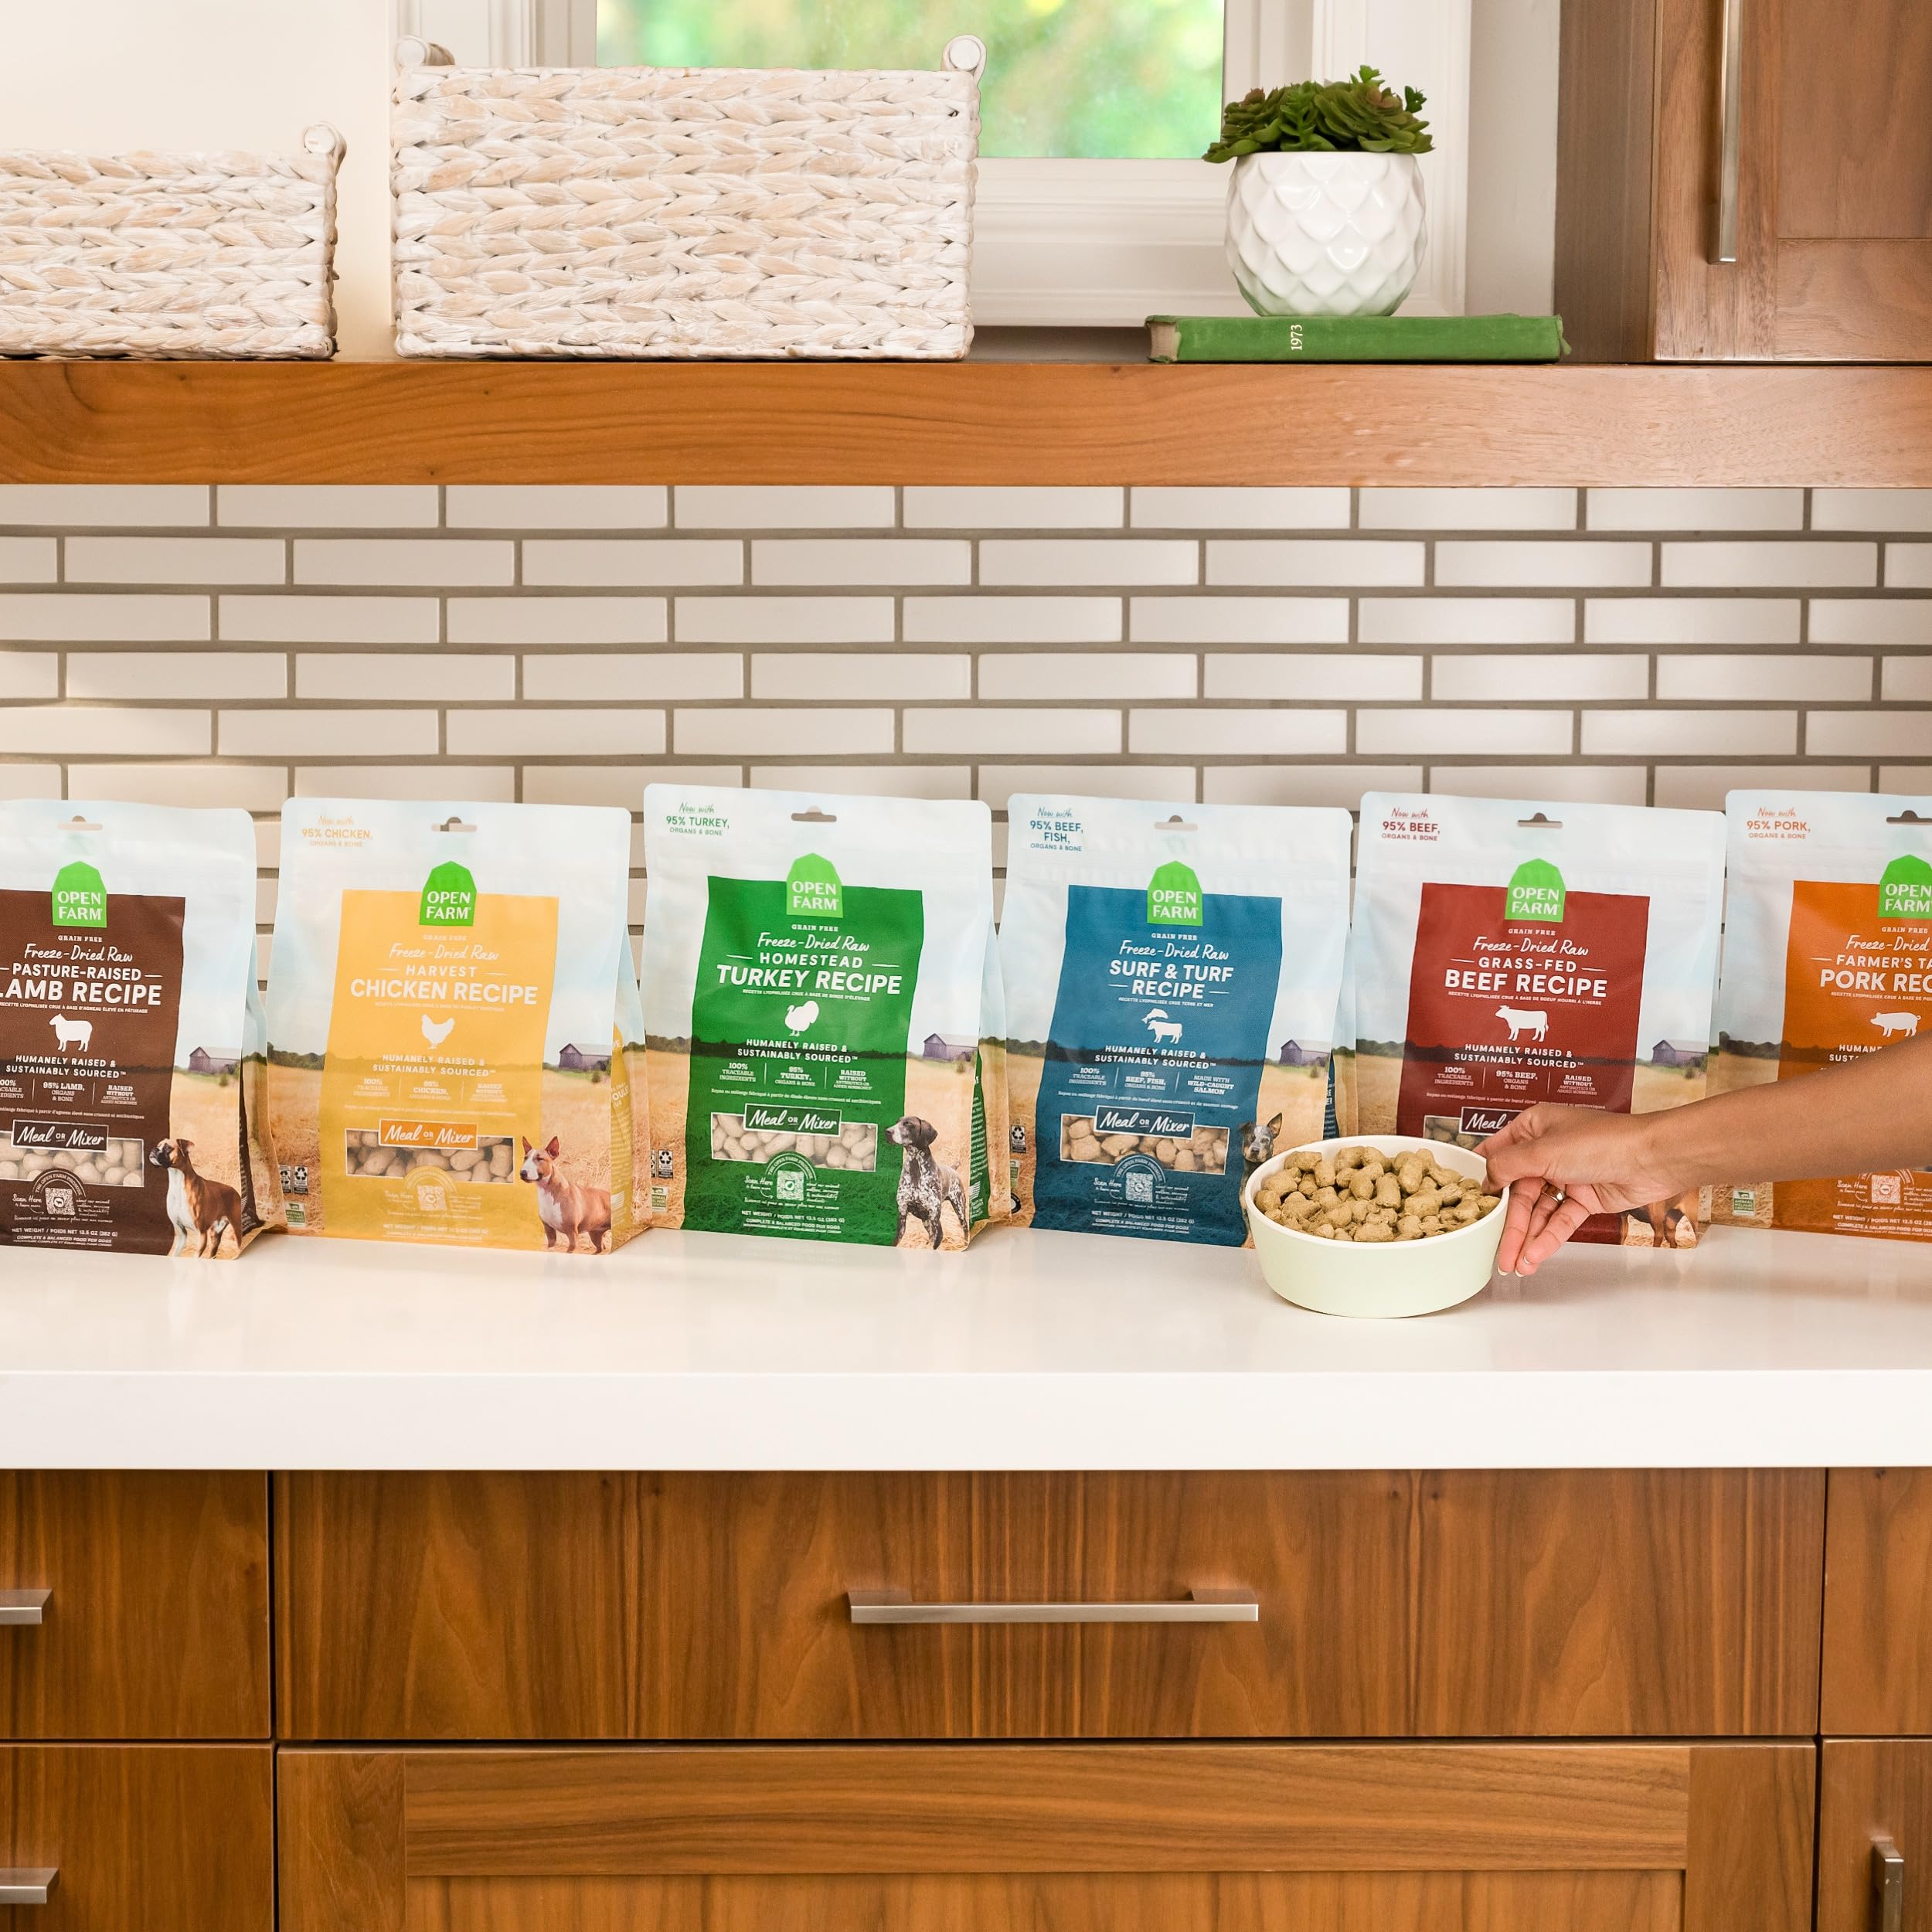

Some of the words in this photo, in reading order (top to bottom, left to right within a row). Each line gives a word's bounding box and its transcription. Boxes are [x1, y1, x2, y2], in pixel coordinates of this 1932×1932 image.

[1290, 324, 1303, 351] 1973
[679, 801, 695, 813] Now
[699, 804, 714, 813] with
[1037, 806, 1053, 816] Now
[1056, 808, 1072, 817] with
[1392, 808, 1408, 818] Now
[1412, 808, 1428, 818] with
[1757, 806, 1775, 817] Now
[1777, 807, 1796, 817] with
[666, 816, 685, 825] 95%
[689, 817, 729, 828] TURKEY,
[1030, 820, 1051, 830] 95%
[1055, 821, 1083, 834] BEEF,
[1383, 821, 1406, 831] 95%
[1410, 822, 1440, 834] BEEF,
[1747, 821, 1770, 829] 95%
[1774, 821, 1811, 832] PORK,
[301, 828, 321, 838] 95%
[1044, 832, 1070, 844] FISH,
[792, 881, 836, 896] OPEN
[1512, 886, 1560, 902] OPEN
[1885, 883, 1932, 897] OPEN
[57, 891, 100, 905] OPEN
[427, 891, 470, 904] OPEN
[793, 896, 837, 910] FARM
[1152, 889, 1196, 904] OPEN
[1153, 905, 1197, 919] FARM
[1512, 902, 1559, 916] FARM
[1885, 899, 1930, 912] FARM
[59, 907, 101, 920] FARM
[426, 906, 469, 920] FARM
[757, 932, 841, 950] Freeze-Dried
[842, 936, 869, 951] Raw
[1473, 936, 1558, 954] Freeze-Dried
[1560, 940, 1589, 956] Raw
[1846, 935, 1930, 951] Freeze-Dried
[24, 944, 106, 961] Freeze-Dried
[107, 946, 133, 961] Raw
[389, 943, 467, 959] Freeze-Dried
[470, 944, 500, 961] Raw
[1119, 940, 1199, 958] Freeze-Dried
[1202, 944, 1229, 960] Raw
[760, 952, 862, 968] HOMESTEAD
[1478, 957, 1577, 972] GRASS-FED
[1836, 954, 1912, 968] FARMER'S
[12, 963, 141, 981] PASTURE-RAISED
[406, 964, 477, 977] HARVEST
[1110, 960, 1162, 978] SURF
[1165, 964, 1178, 979] &
[1183, 964, 1234, 982] TURF
[717, 964, 810, 988] TURKEY
[815, 971, 902, 995] RECIPE
[1445, 969, 1509, 991] BEEF
[1516, 974, 1607, 997] RECIPE
[1820, 970, 1886, 991] PORK
[0, 978, 63, 1001] AMB
[72, 981, 162, 1005] RECIPE
[350, 979, 447, 1000] CHICKEN
[454, 982, 538, 1005] RECIPE
[1131, 980, 1205, 998] RECIPE
[747, 1039, 798, 1049] HUMANELY
[803, 1043, 837, 1052] RAISED
[1105, 1045, 1158, 1056] HUMANELY
[1161, 1049, 1196, 1058] RAISED
[1465, 1044, 1520, 1053] HUMANELY
[1524, 1047, 1562, 1057] RAISED
[15, 1055, 67, 1064] HUMANELY
[72, 1058, 106, 1067] RAISED
[383, 1054, 433, 1063] HUMANELY
[438, 1057, 474, 1066] RAISED
[738, 1049, 801, 1060] SUSTAINABLY
[1095, 1055, 1158, 1065] SUSTAINABLY
[1454, 1053, 1522, 1065] SUSTAINABLY
[6, 1065, 69, 1076] SUSTAINABLY
[372, 1064, 436, 1073] SUSTAINABLY
[1515, 1071, 1538, 1080] BEEF,
[60, 1083, 85, 1091] LAMB,
[1188, 1081, 1235, 1090] WILD-CAUGHT
[749, 1109, 787, 1126] Meal
[798, 1114, 837, 1131] Mixer
[1100, 1111, 1139, 1128] Meal
[1150, 1116, 1189, 1133] Mixer
[1465, 1113, 1507, 1129] Meal
[17, 1126, 56, 1143] Meal
[66, 1130, 104, 1147] Mixer
[385, 1124, 423, 1141] Meal
[435, 1128, 474, 1145] Mixer
[12, 1193, 26, 1202] Scan
[29, 1194, 42, 1202] Here
